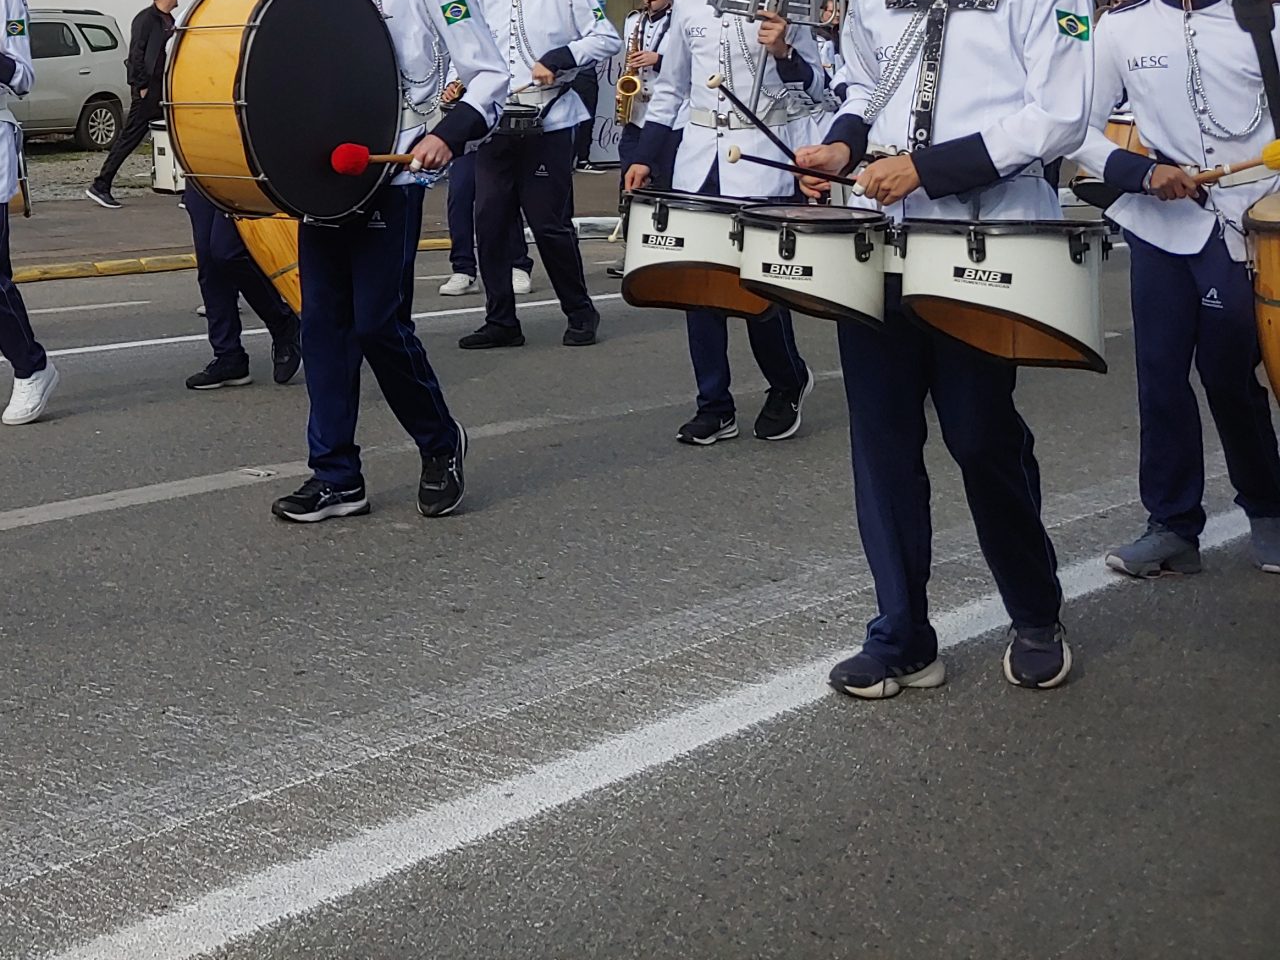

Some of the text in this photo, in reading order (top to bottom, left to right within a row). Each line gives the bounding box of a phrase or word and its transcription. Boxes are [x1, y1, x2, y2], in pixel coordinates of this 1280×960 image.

[922, 71, 935, 102] BNB
[648, 235, 676, 246] BNB
[770, 264, 803, 276] BNB
[963, 268, 1002, 283] BNB
